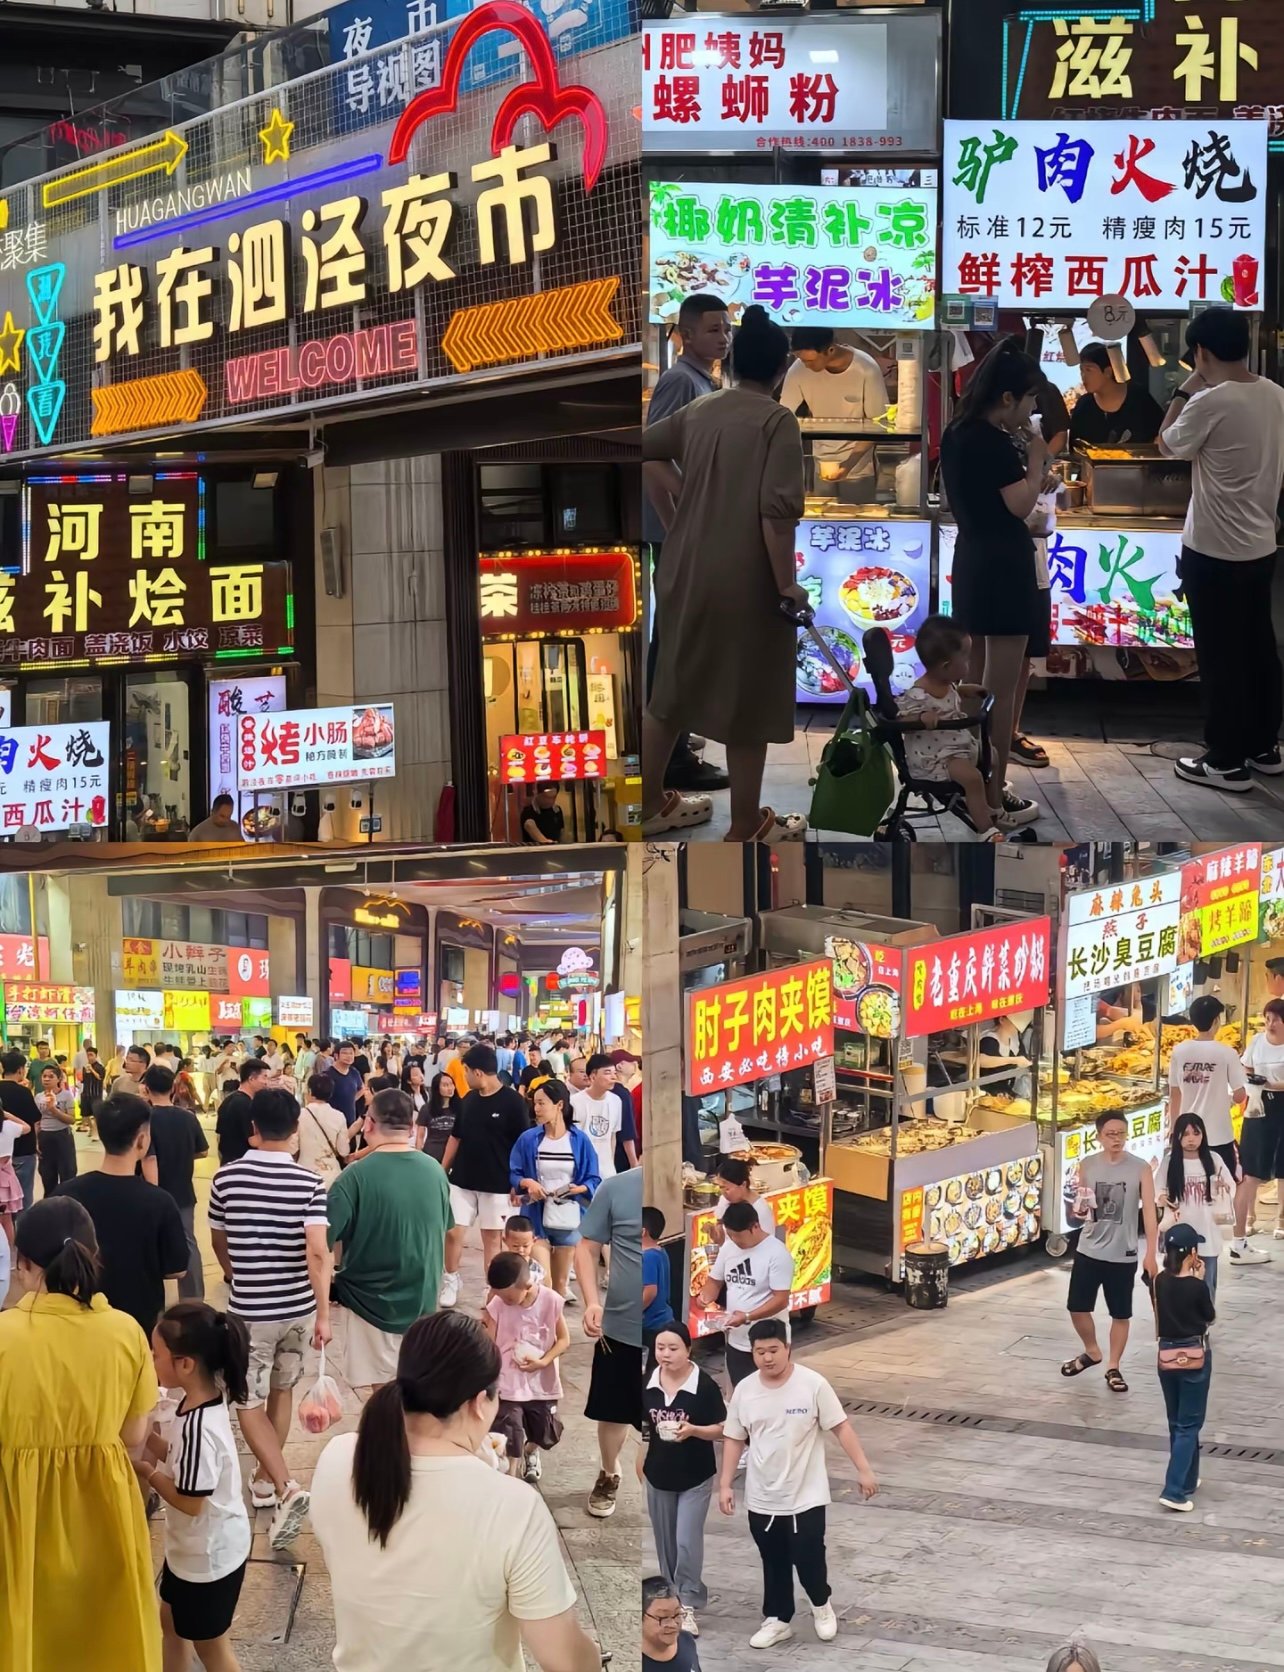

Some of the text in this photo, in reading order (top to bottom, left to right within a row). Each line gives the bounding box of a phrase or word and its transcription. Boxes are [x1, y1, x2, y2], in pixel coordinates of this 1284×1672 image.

[345, 38, 441, 114] 导视图
[642, 31, 786, 71] 肥姨妈
[1048, 15, 1258, 101] 滋补
[653, 72, 839, 124] 螺蛳粉
[842, 136, 903, 147] 1838-993
[952, 129, 1257, 204] 驴肉火烧
[115, 167, 252, 236] HUAGANGWAN
[660, 195, 930, 248] 椰奶清补凉
[956, 214, 1252, 240] 标准12元 精瘦肉15元
[0, 221, 48, 271] 聚集
[92, 142, 557, 363] 我在泗泾夜市
[752, 264, 905, 312] 芋泥冰
[957, 252, 1218, 299] 鲜榨西瓜汁
[226, 319, 418, 405] WELCOME
[44, 500, 186, 562] 河南
[480, 573, 518, 617] 茶
[1047, 532, 1186, 610] 肉火
[0, 564, 264, 633] 补烩面
[0, 636, 75, 662] 牛肉面
[85, 631, 153, 657] 盖浇饭
[164, 627, 208, 651] 水饺
[261, 718, 348, 767] 烤小肠
[23, 774, 102, 793] 精瘦肉15元
[1067, 925, 1178, 981] 长沙臭豆腐
[694, 966, 831, 1061] 肘子肉夹馍
[1083, 1110, 1163, 1154] 长豆腐
[769, 1183, 829, 1225] 夹馍
